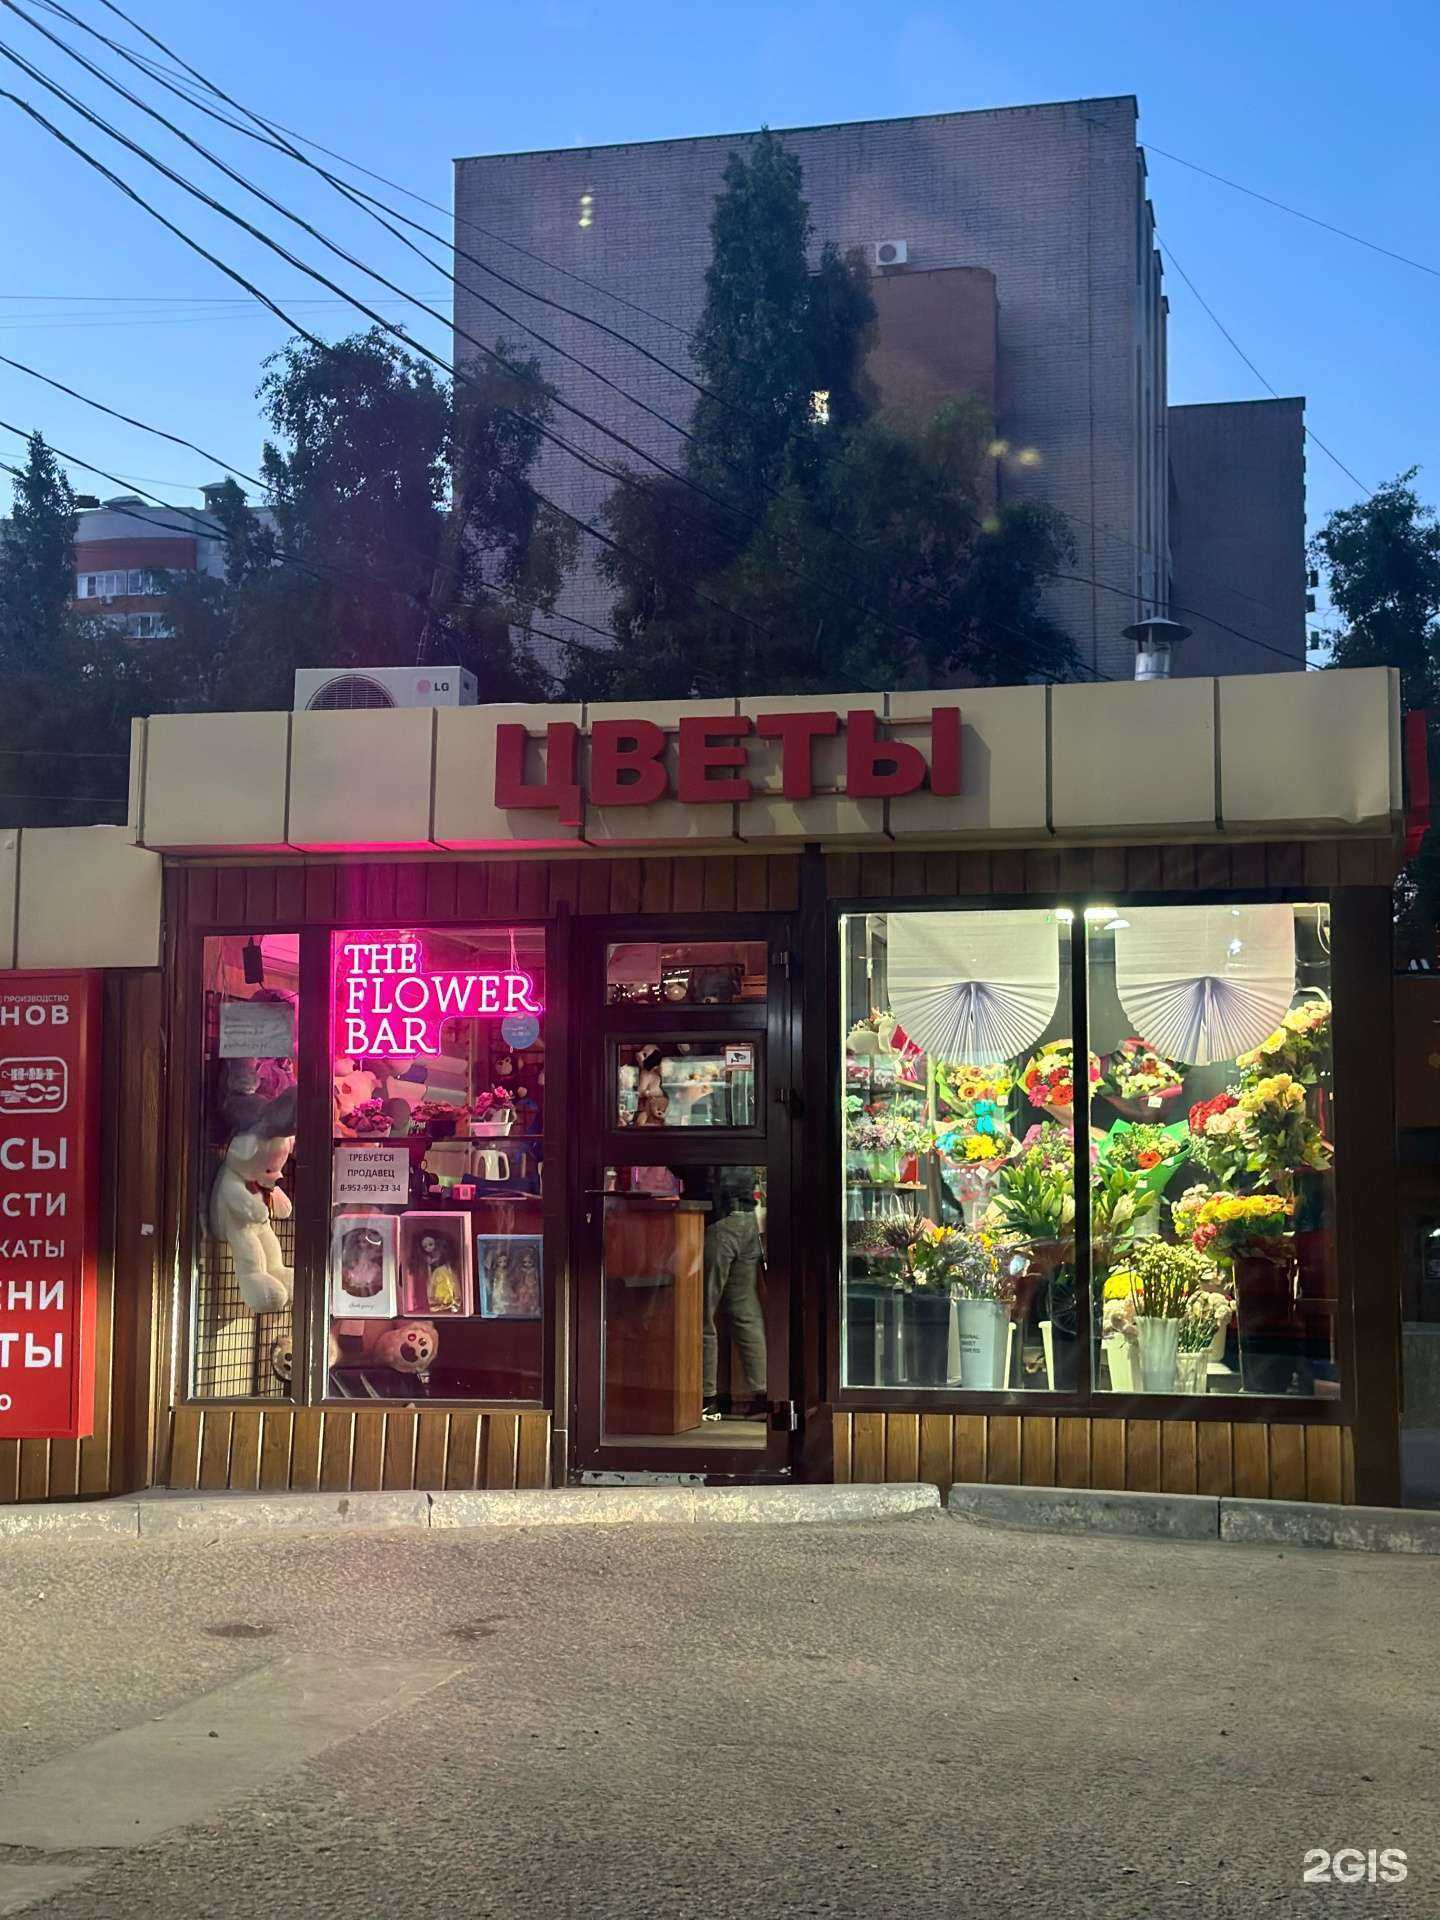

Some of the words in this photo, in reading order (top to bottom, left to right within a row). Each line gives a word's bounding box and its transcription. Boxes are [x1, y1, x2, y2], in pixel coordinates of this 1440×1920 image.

[434, 682, 450, 691] LG
[494, 706, 962, 827] ЦВЕТЫ
[343, 942, 418, 974] THE
[345, 974, 539, 1013] FLOWER
[343, 1016, 438, 1054] BAR
[348, 1153, 395, 1162] ТРЕБУЕТСЯ
[347, 1169, 396, 1179] ПРОДАВЕЦ
[0, 1280, 64, 1310] НИ
